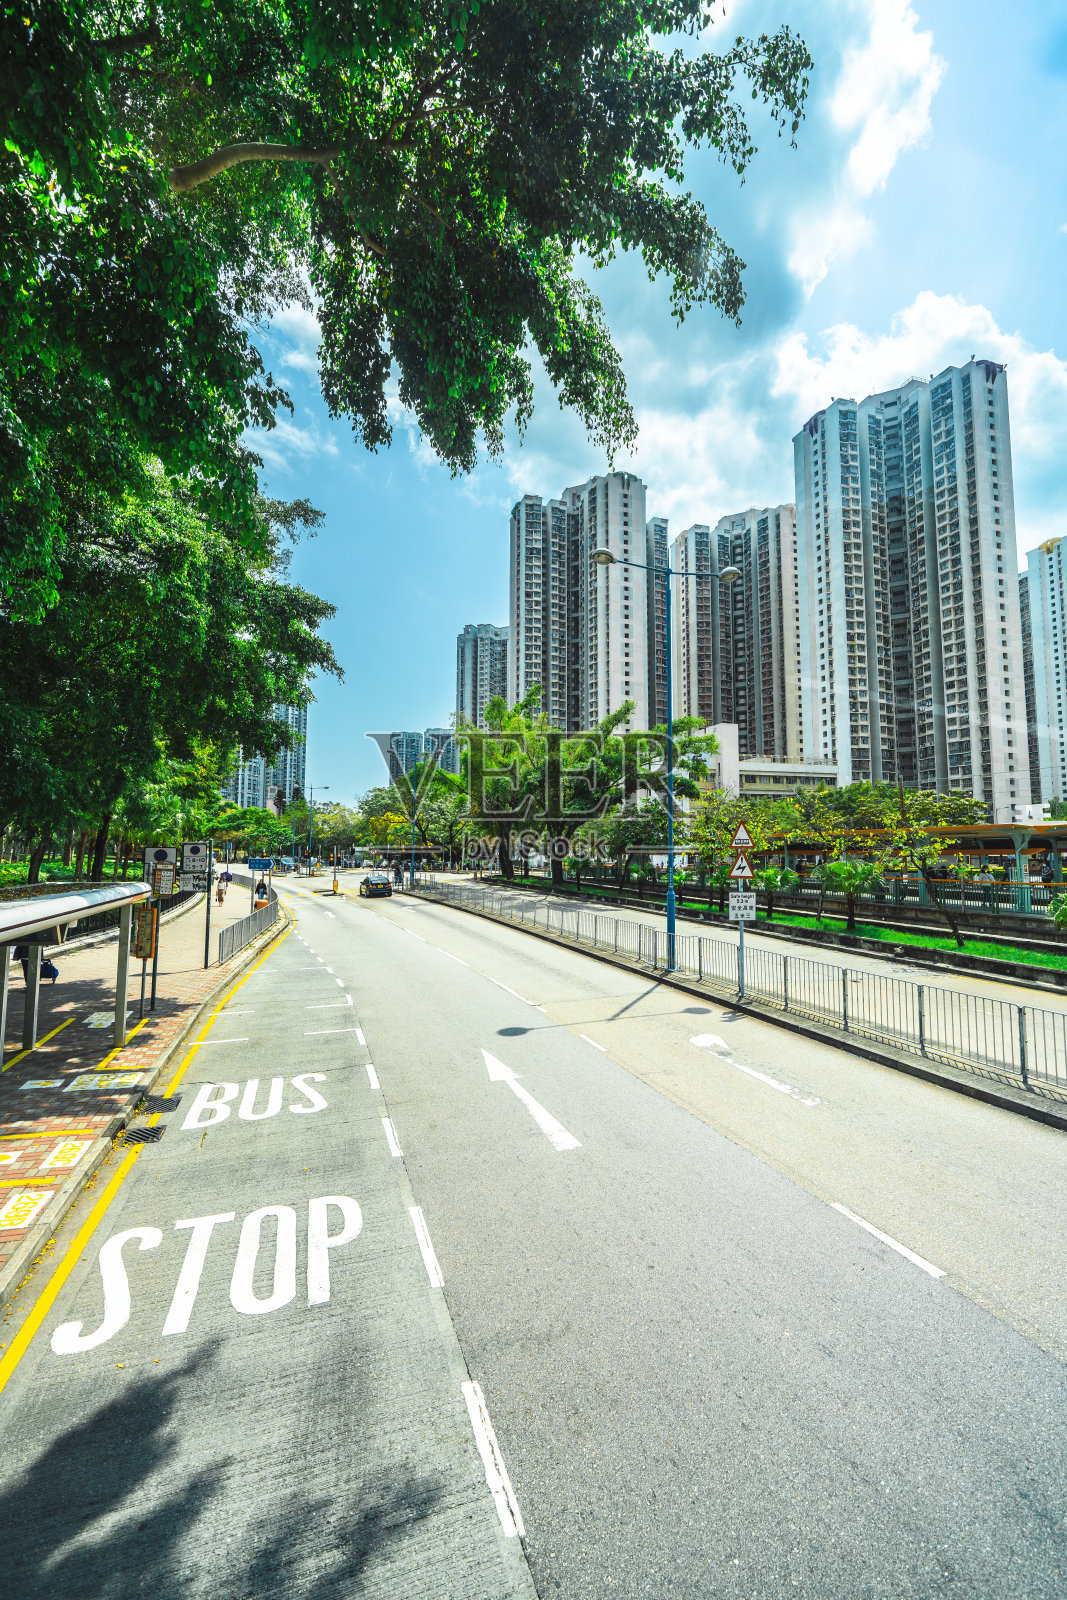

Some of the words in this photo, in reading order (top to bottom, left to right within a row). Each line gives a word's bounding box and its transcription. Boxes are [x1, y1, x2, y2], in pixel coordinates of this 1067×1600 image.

[180, 1073, 328, 1130] BUS
[48, 1142, 85, 1166] 269C
[0, 1193, 44, 1227] 269B
[51, 1195, 363, 1355] STOP
